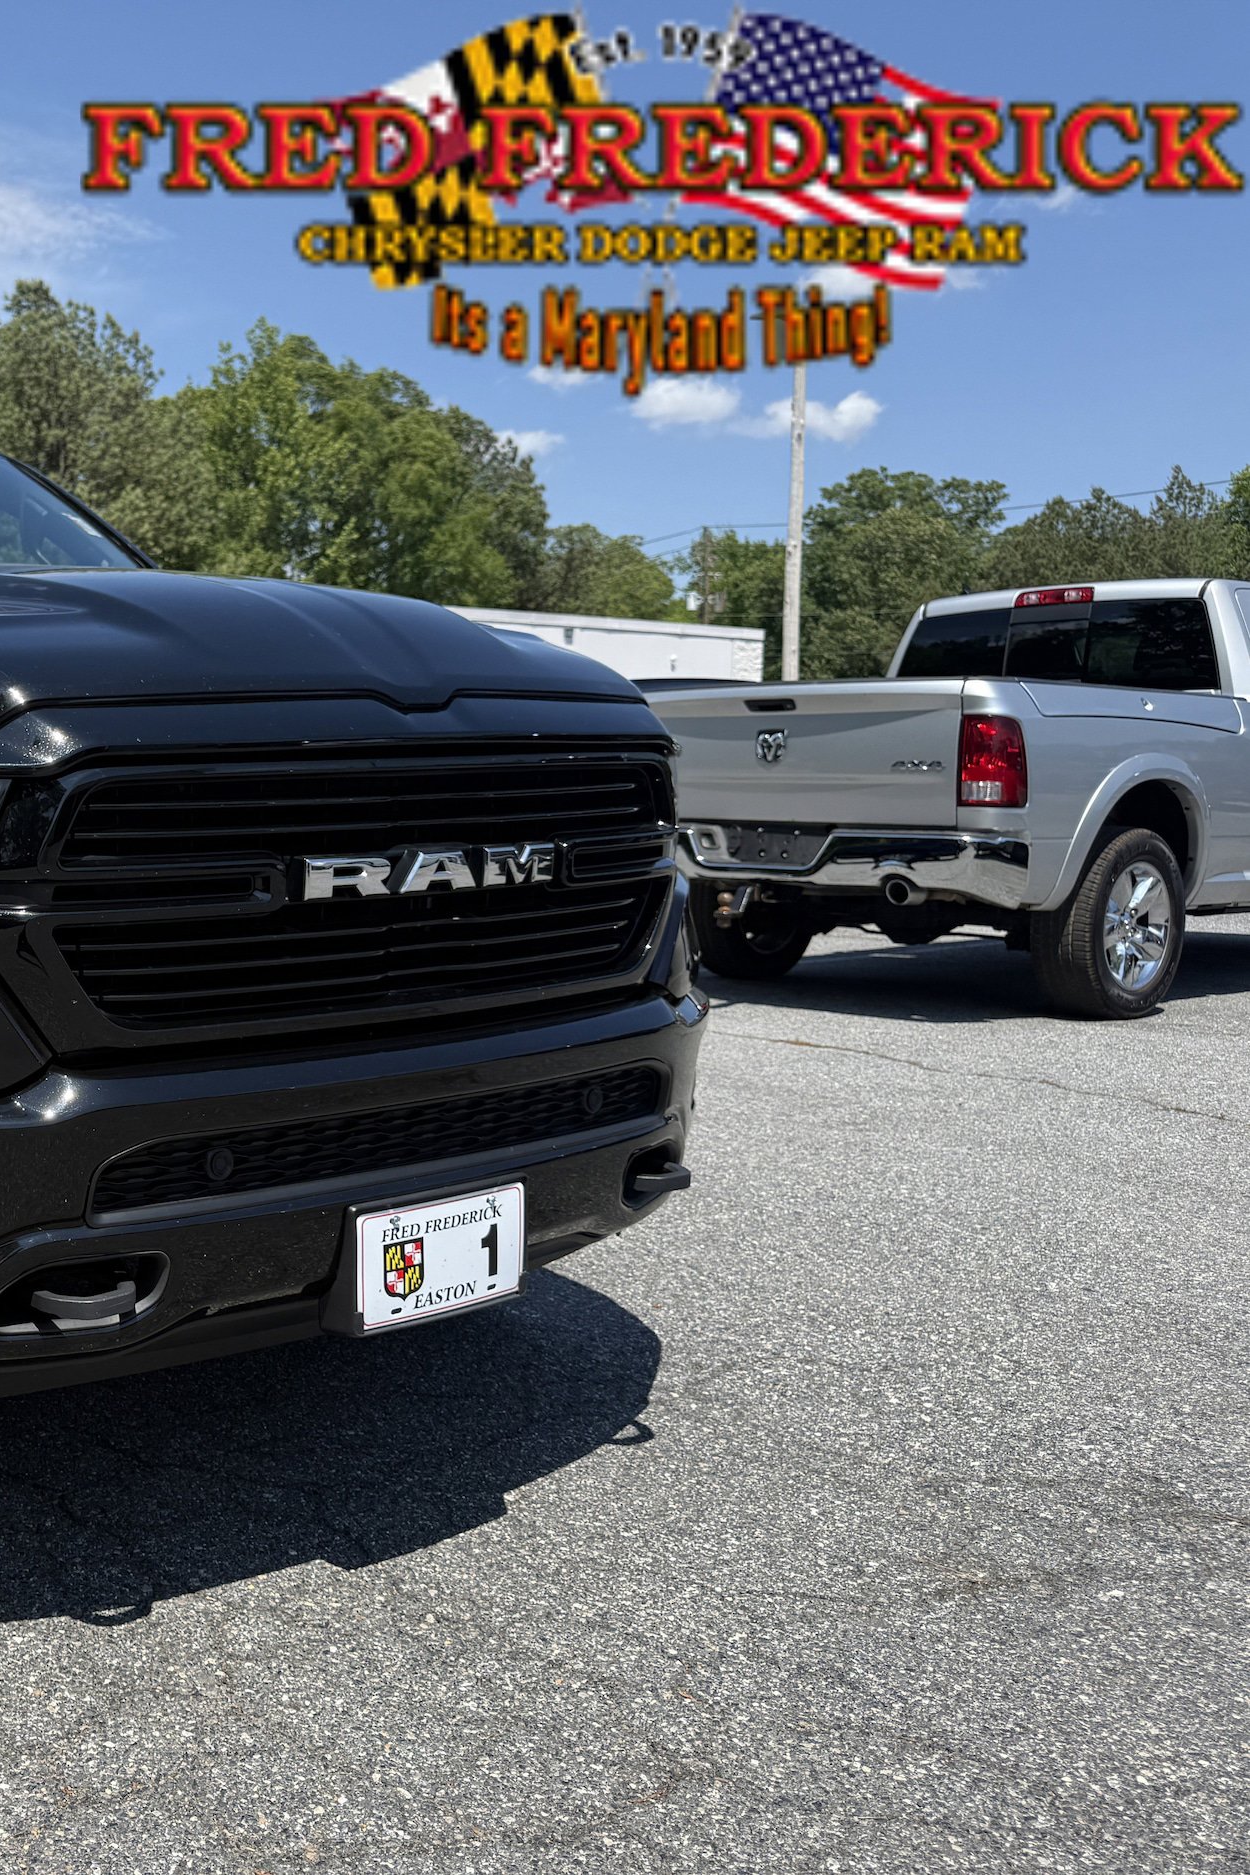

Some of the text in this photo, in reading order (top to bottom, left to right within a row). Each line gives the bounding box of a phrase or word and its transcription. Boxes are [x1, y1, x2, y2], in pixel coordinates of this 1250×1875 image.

[303, 843, 554, 900] RAM
[381, 1204, 503, 1242] FRED FREDERICK
[481, 1223, 498, 1277] 1
[413, 1280, 477, 1310] EASTON
